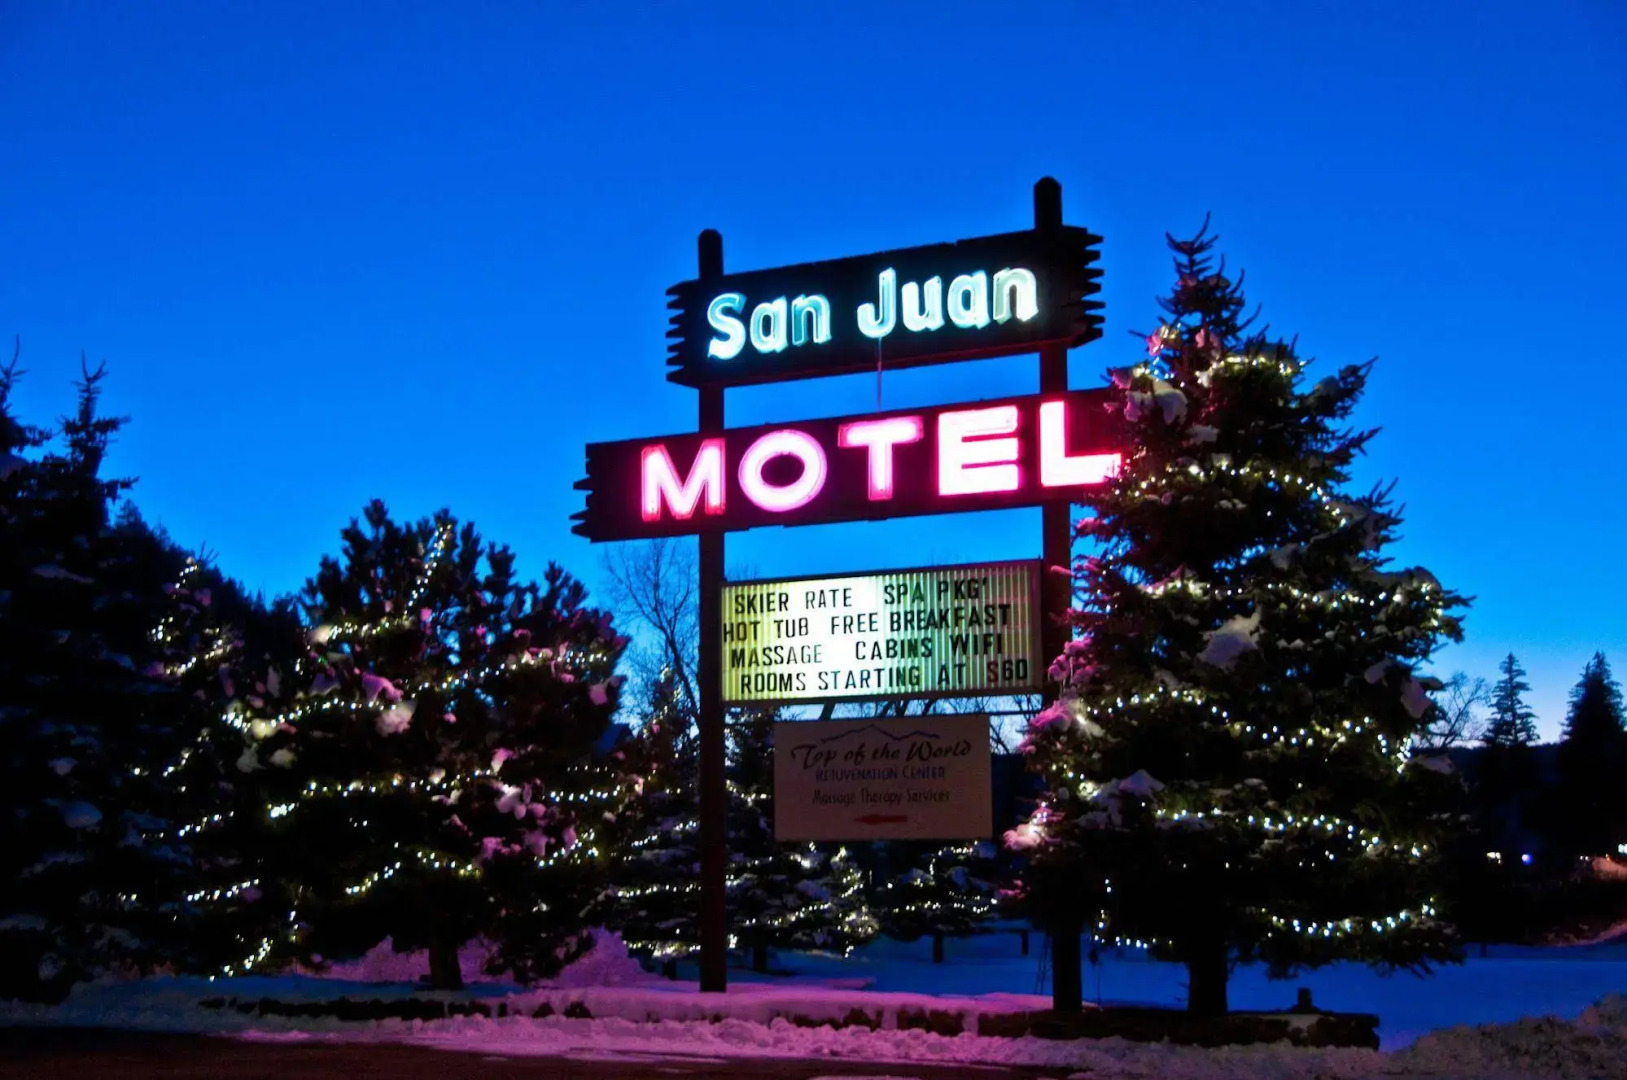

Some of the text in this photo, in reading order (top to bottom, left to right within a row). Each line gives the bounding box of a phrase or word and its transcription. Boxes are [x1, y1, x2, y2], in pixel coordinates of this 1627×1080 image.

[706, 266, 1039, 360] San Juan
[640, 400, 1122, 522] MOTEL
[734, 592, 790, 615] SKIER
[805, 587, 853, 609] RATE
[884, 582, 925, 606] SPA
[723, 603, 1012, 643] HOT TUB FREE BREAKFAST
[731, 632, 1003, 669] MASSAGE CABINS WIFI
[740, 672, 807, 694] ROOMS
[817, 665, 921, 692] STARTING
[937, 664, 966, 686] AT
[791, 739, 972, 770] Top of the World
[902, 765, 946, 781] CENTER
